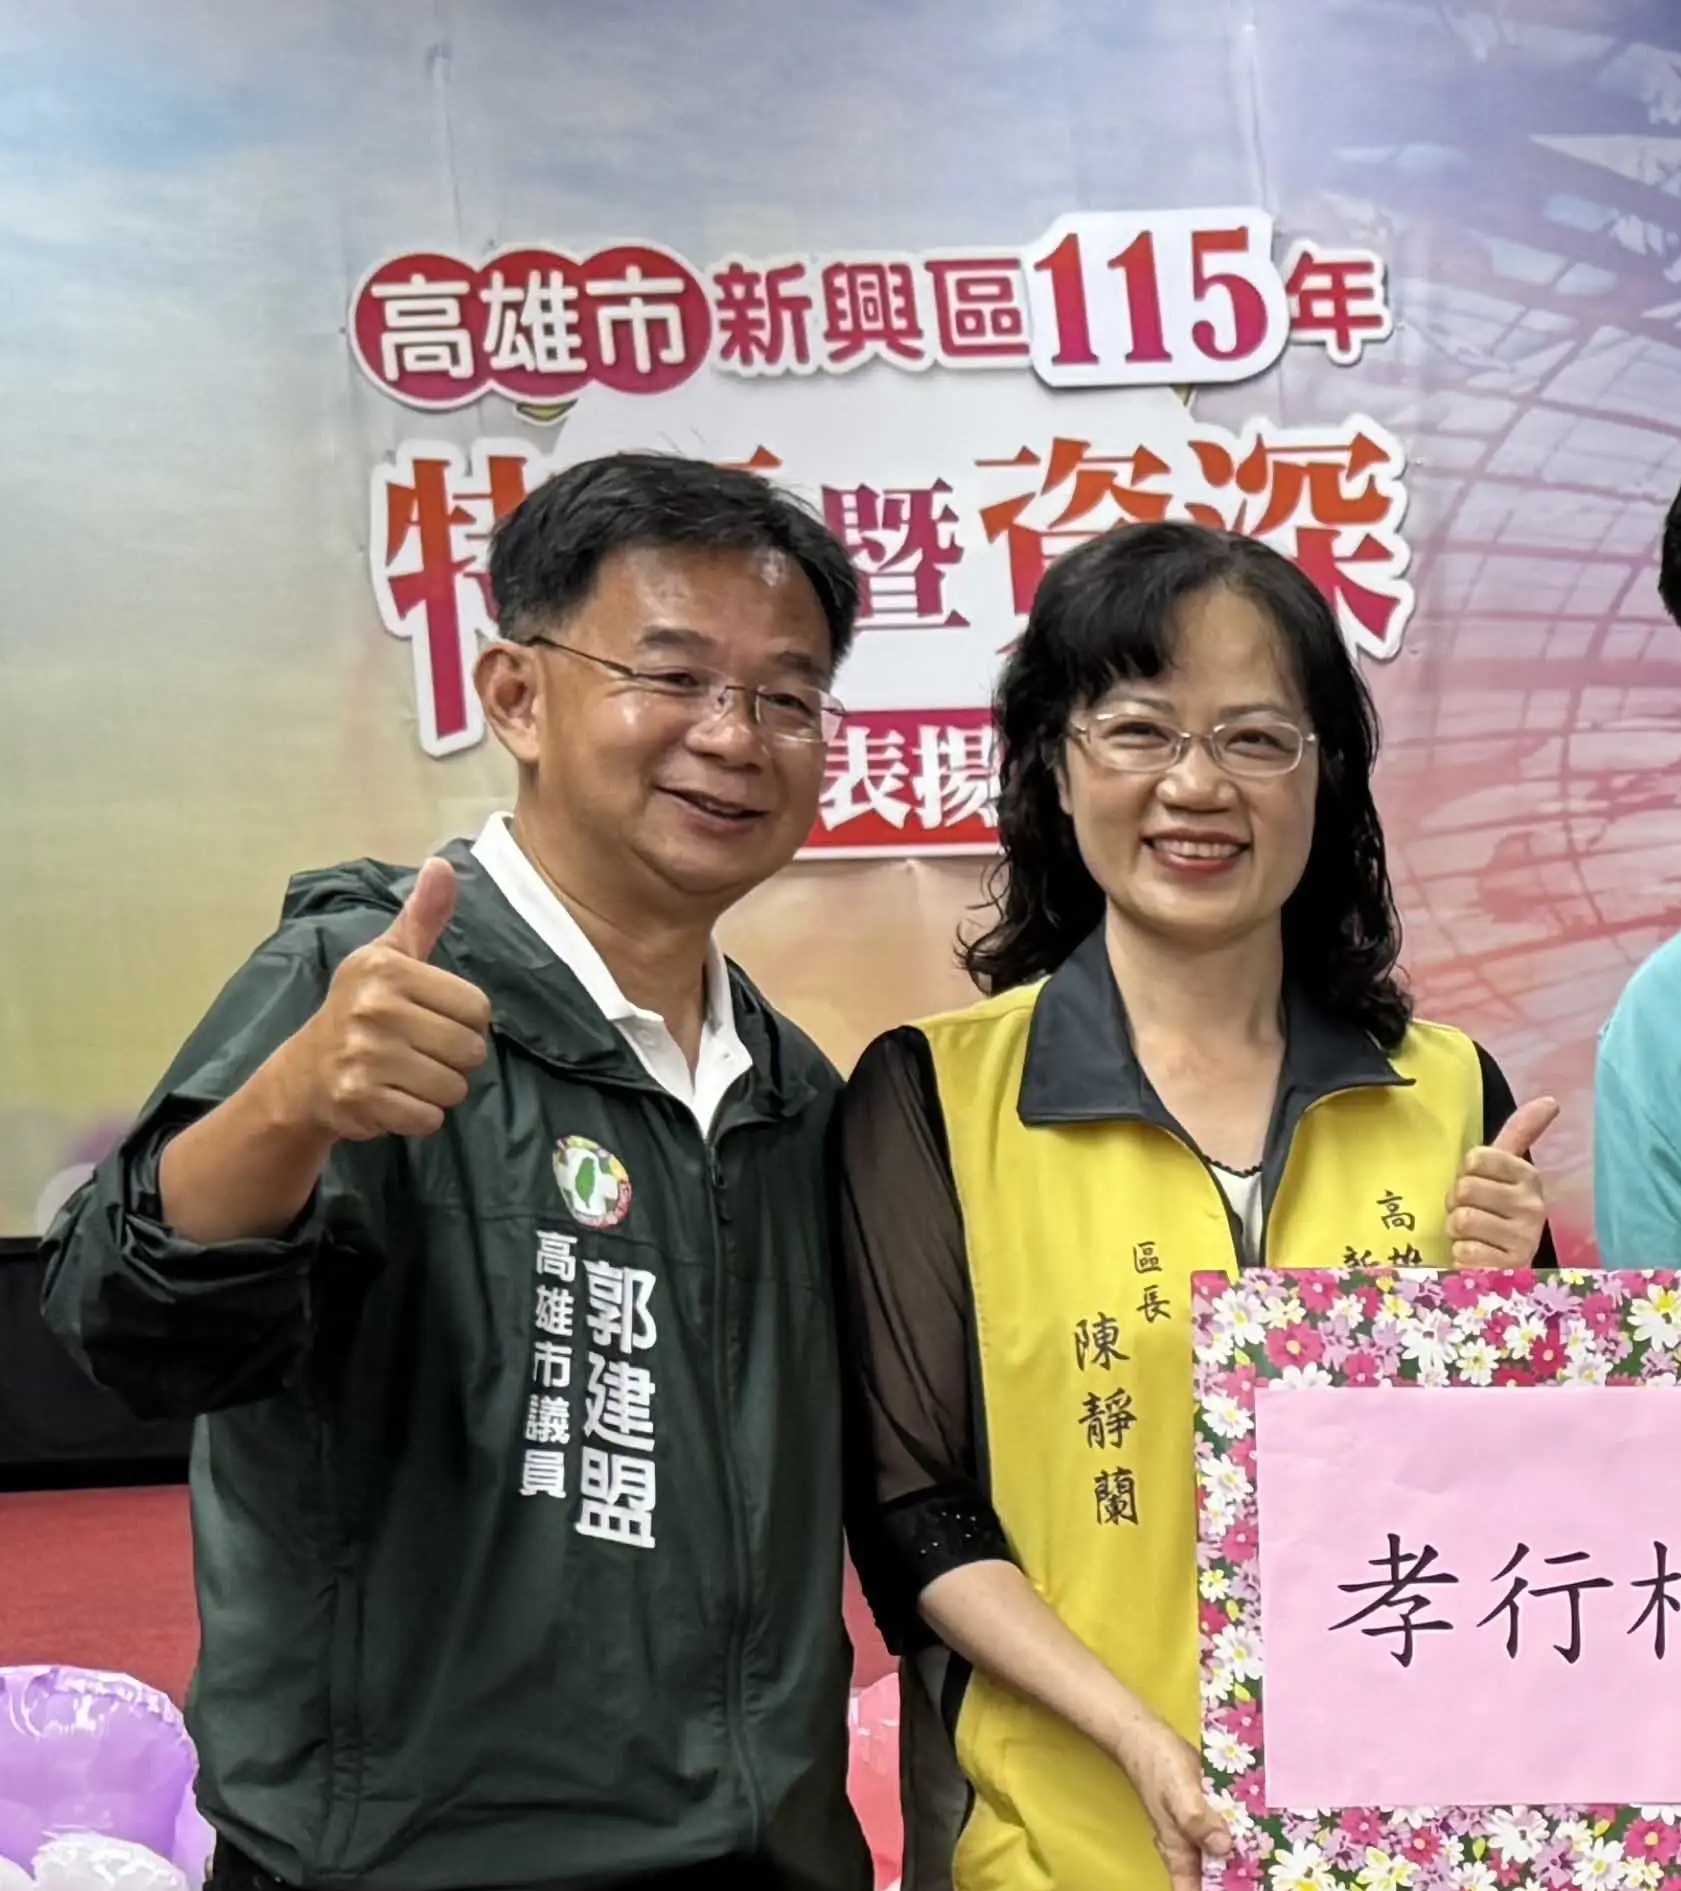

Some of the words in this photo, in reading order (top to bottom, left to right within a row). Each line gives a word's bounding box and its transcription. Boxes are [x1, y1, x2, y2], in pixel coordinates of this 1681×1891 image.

[370, 223, 1388, 381] 高雄市新興區115年
[518, 1229, 579, 1499] 高雄市議員
[1132, 1241, 1173, 1324] 區長
[574, 1257, 658, 1549] 郭建盟
[1074, 1311, 1140, 1527] 陳靜蘭
